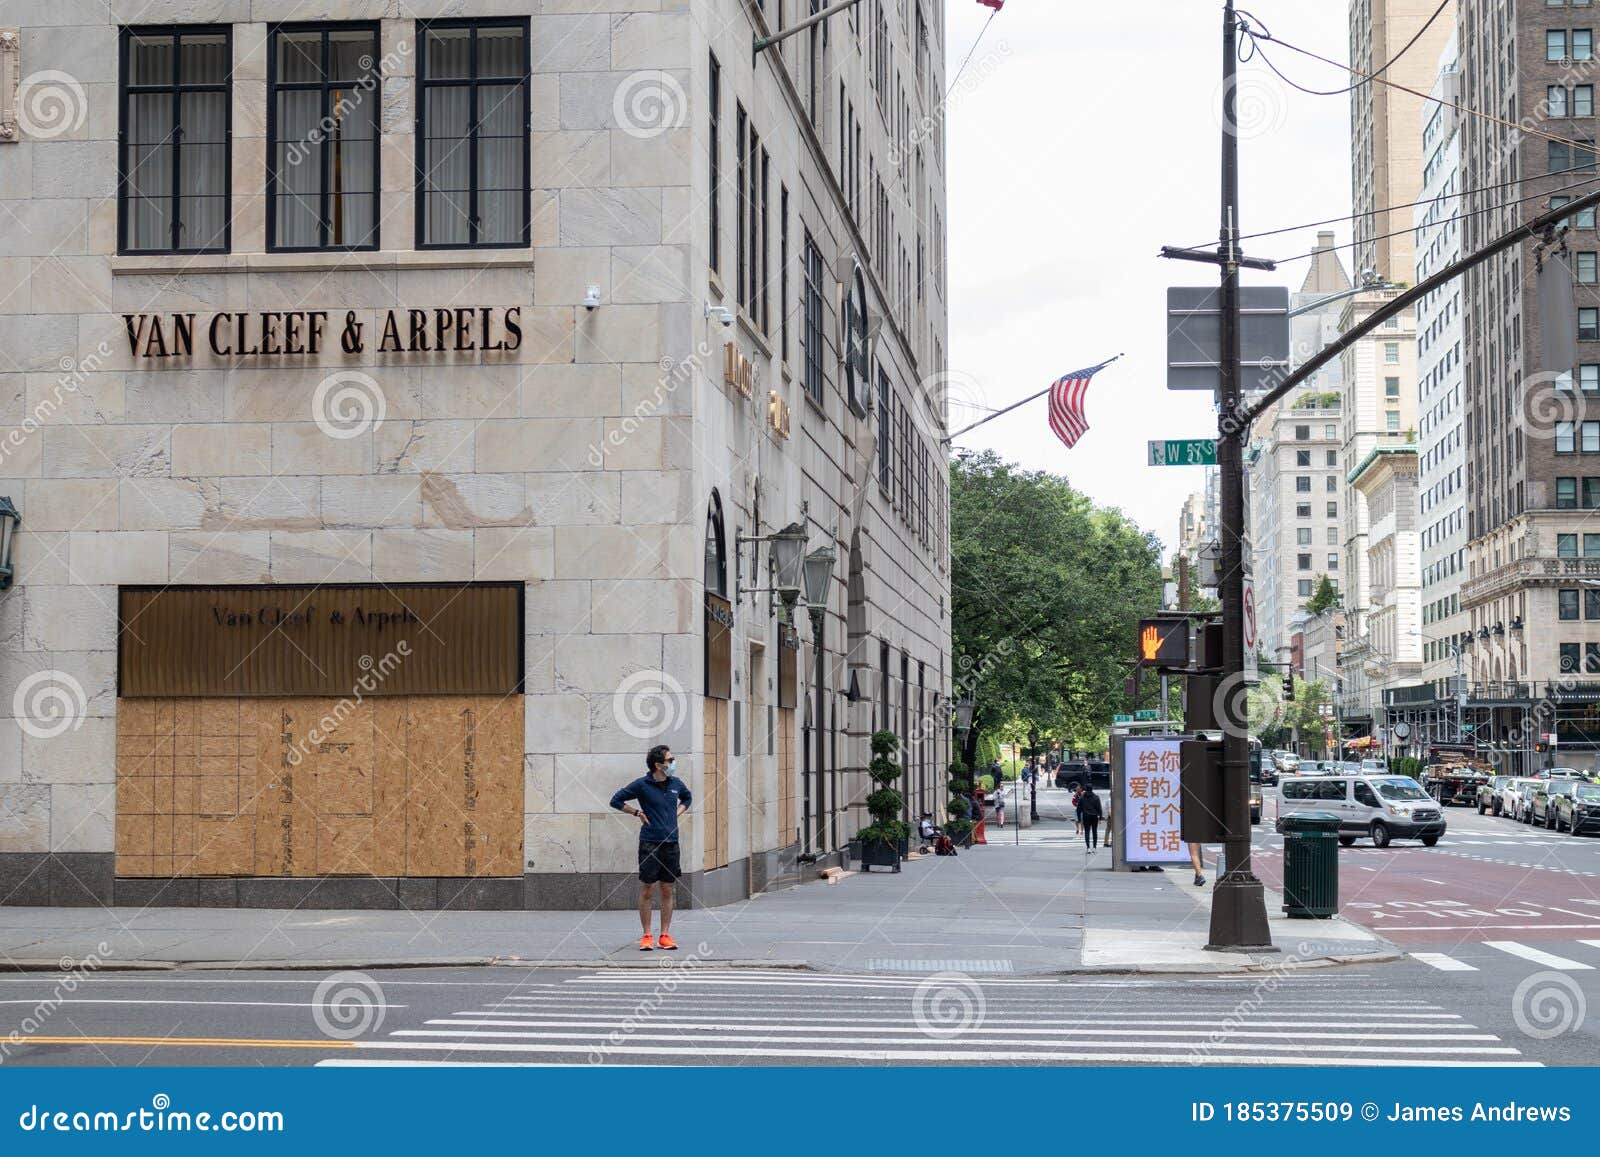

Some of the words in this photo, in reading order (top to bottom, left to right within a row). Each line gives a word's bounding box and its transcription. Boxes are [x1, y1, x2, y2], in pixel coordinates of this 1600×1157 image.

[122, 313, 196, 358] VAN
[208, 310, 327, 356] CLEEF
[341, 309, 364, 354] &
[377, 306, 522, 352] ARPELS
[1167, 443, 1180, 462] W
[1186, 442, 1202, 462] 57
[213, 607, 250, 626] Van
[330, 610, 344, 625] &
[351, 606, 419, 632] Arpels
[1138, 750, 1181, 773] 给你
[1140, 803, 1181, 825] 打个
[1139, 829, 1181, 852] 电话
